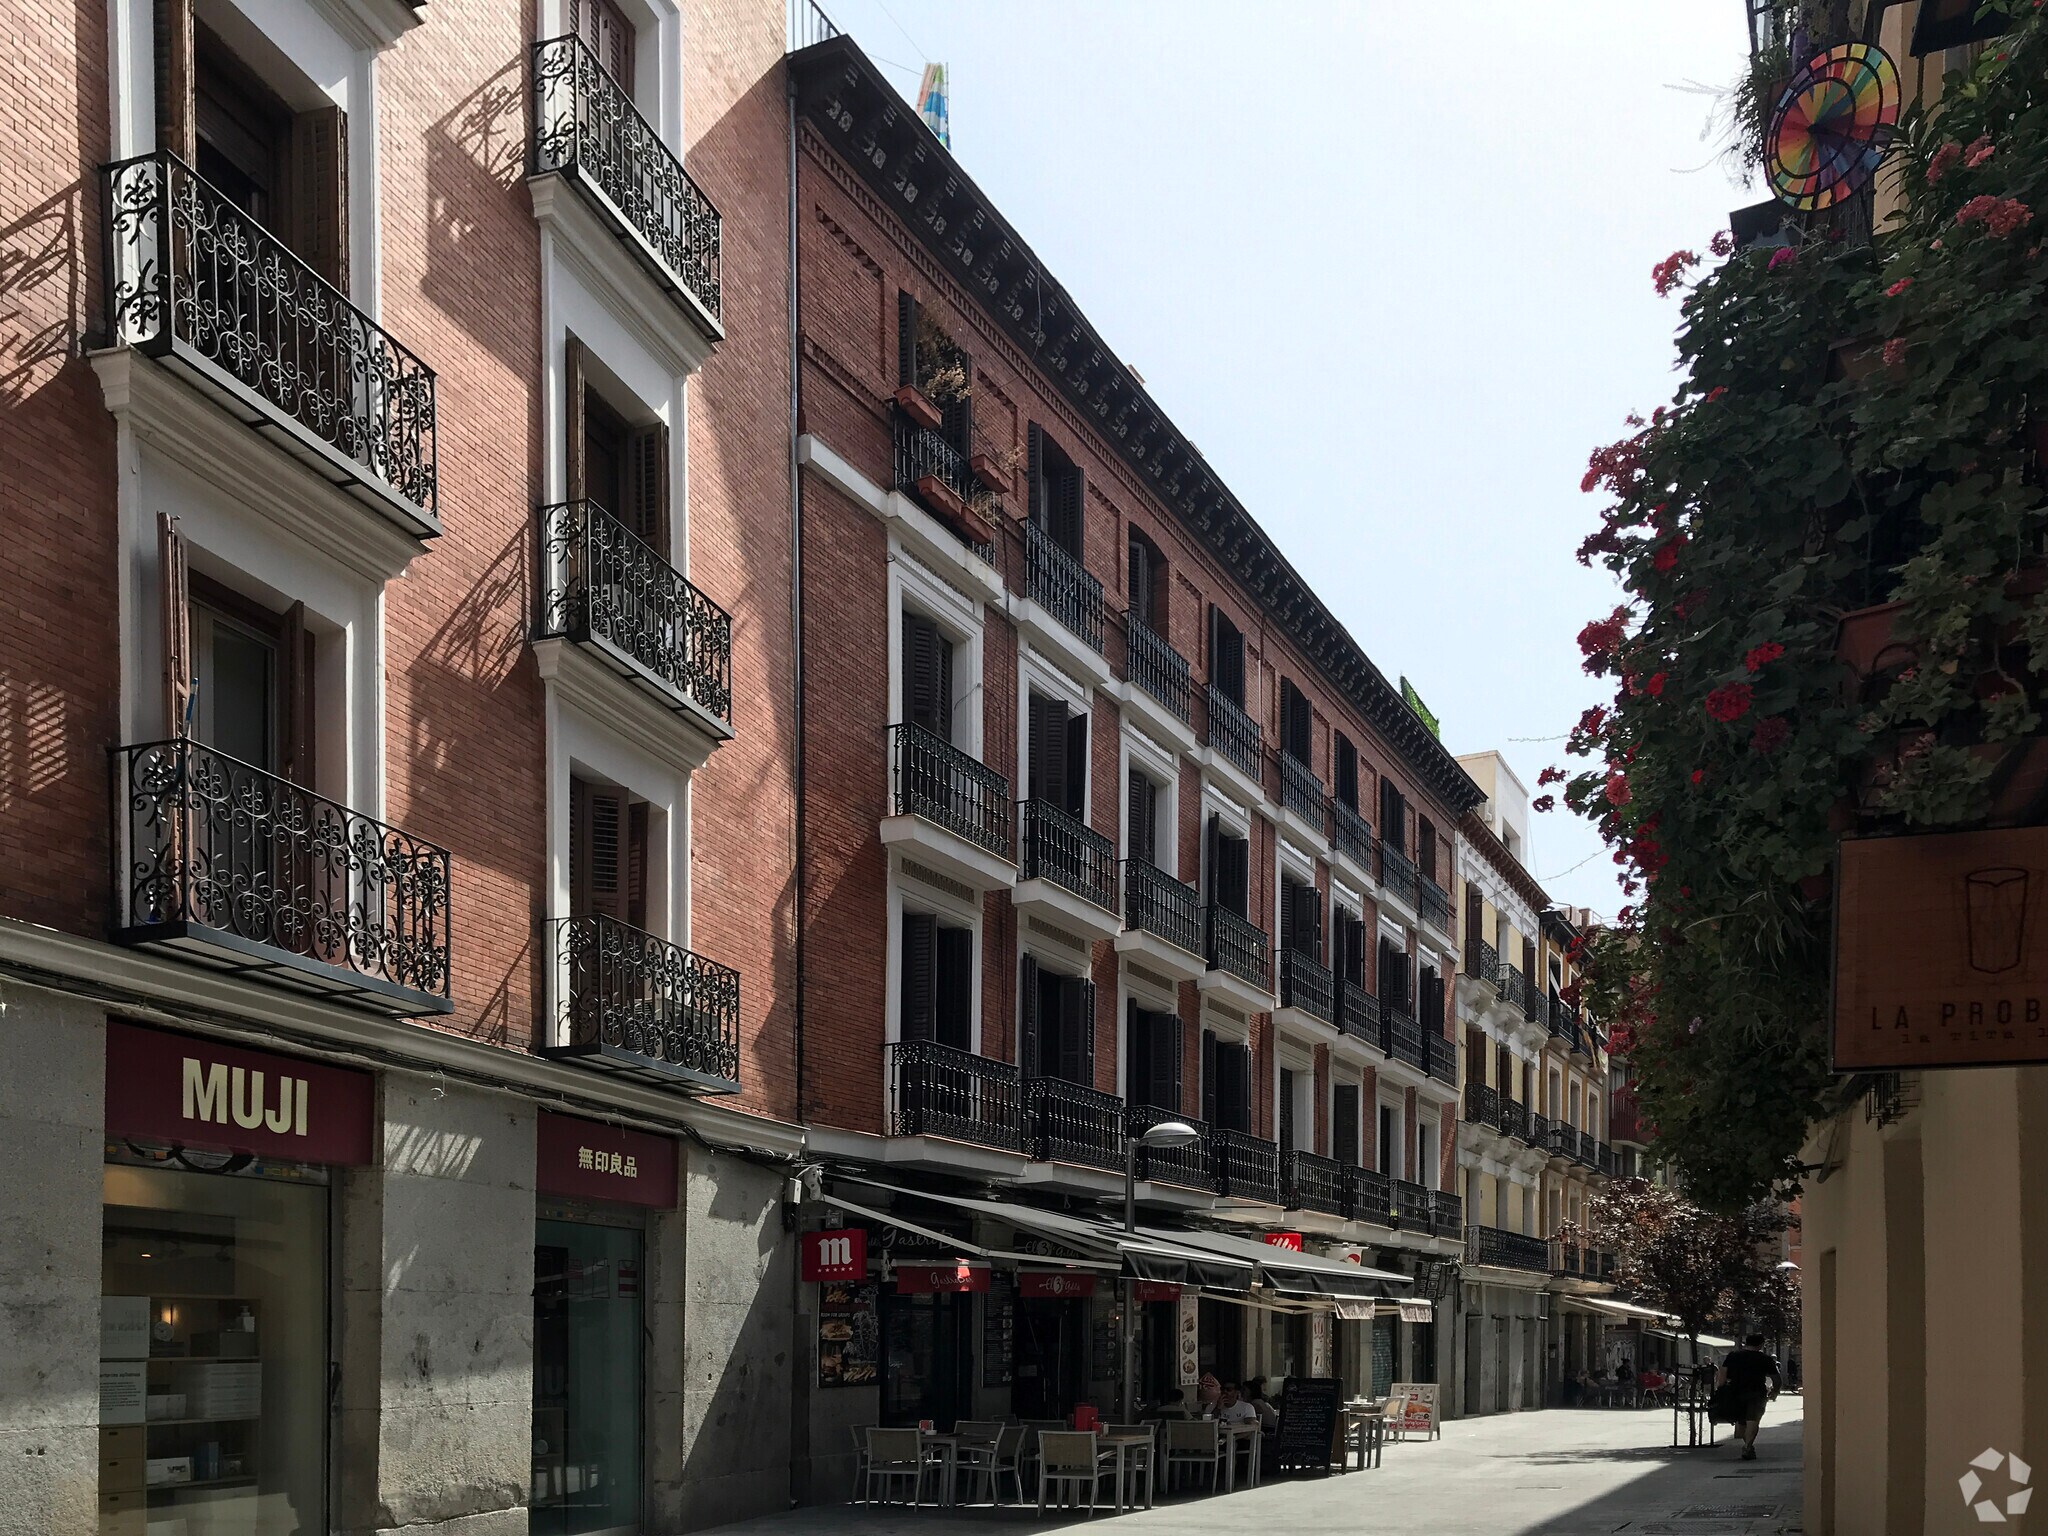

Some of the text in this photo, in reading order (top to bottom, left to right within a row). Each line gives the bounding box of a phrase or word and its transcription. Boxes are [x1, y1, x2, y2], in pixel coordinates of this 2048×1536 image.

[1872, 998, 2040, 1030] LA PROB
[182, 1056, 309, 1137] MUJI
[578, 1145, 638, 1179] 無印良品
